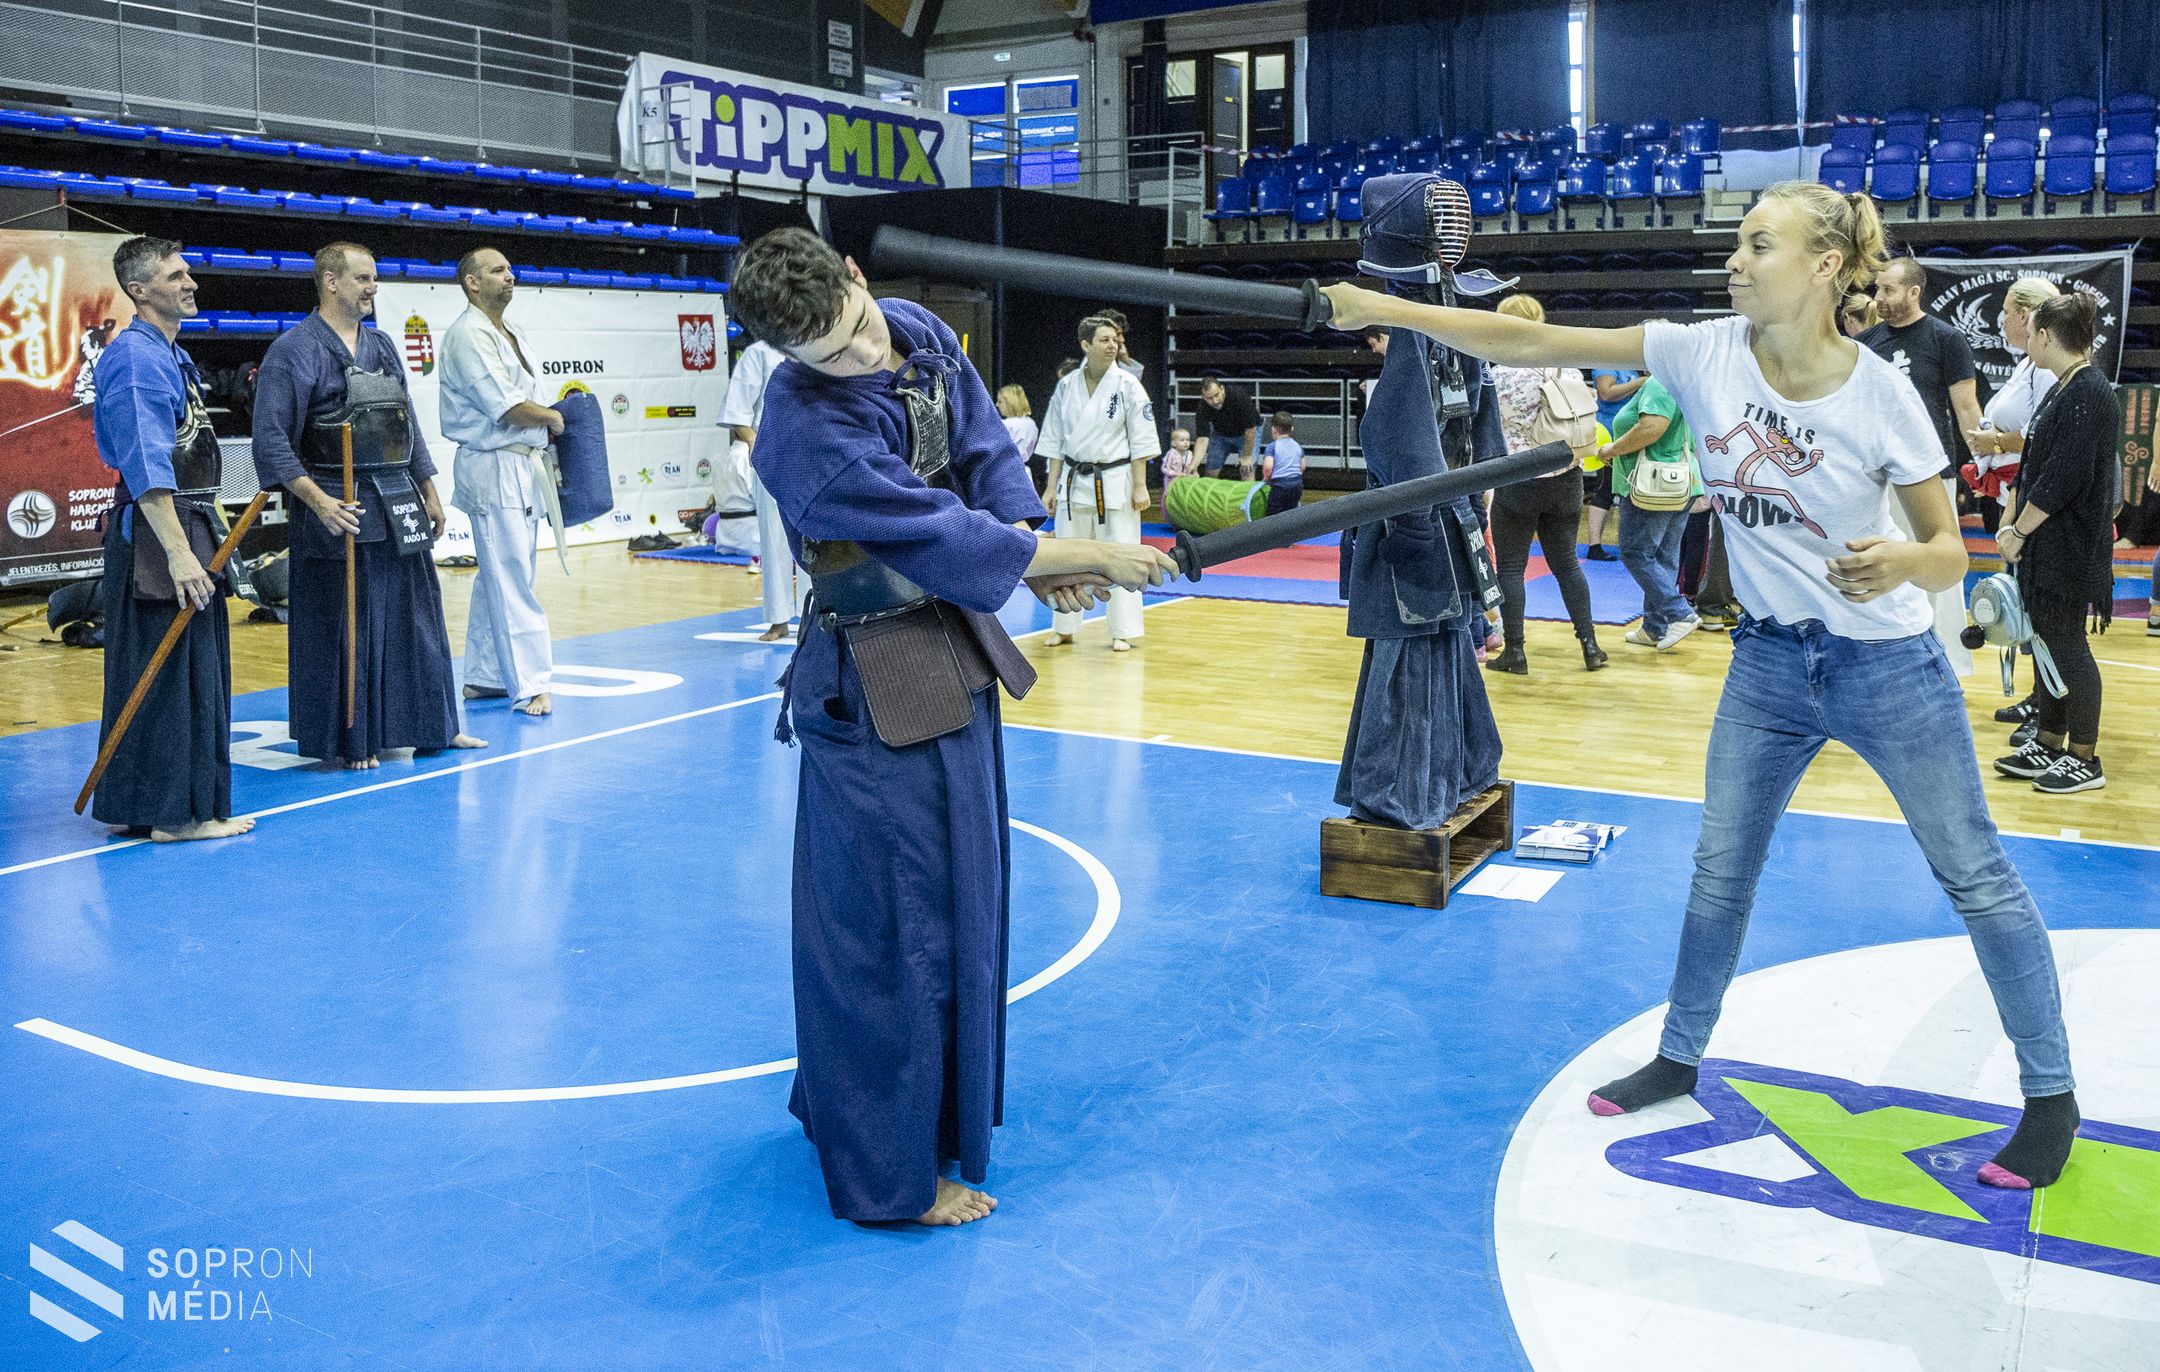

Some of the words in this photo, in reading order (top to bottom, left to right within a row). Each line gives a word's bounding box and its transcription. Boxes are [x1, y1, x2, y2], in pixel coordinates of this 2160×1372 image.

[642, 106, 658, 118] K5
[1930, 284, 1960, 312] KRAV
[1960, 272, 1994, 293] MAGA
[1995, 269, 2015, 283] SC.
[542, 359, 604, 375] SOPRON
[1743, 402, 1788, 432] TIME
[1796, 426, 1816, 446] IS
[69, 487, 116, 502] SOPRONI
[403, 531, 420, 544] RADÓ
[8, 562, 60, 577] JELENTKEZÉS,
